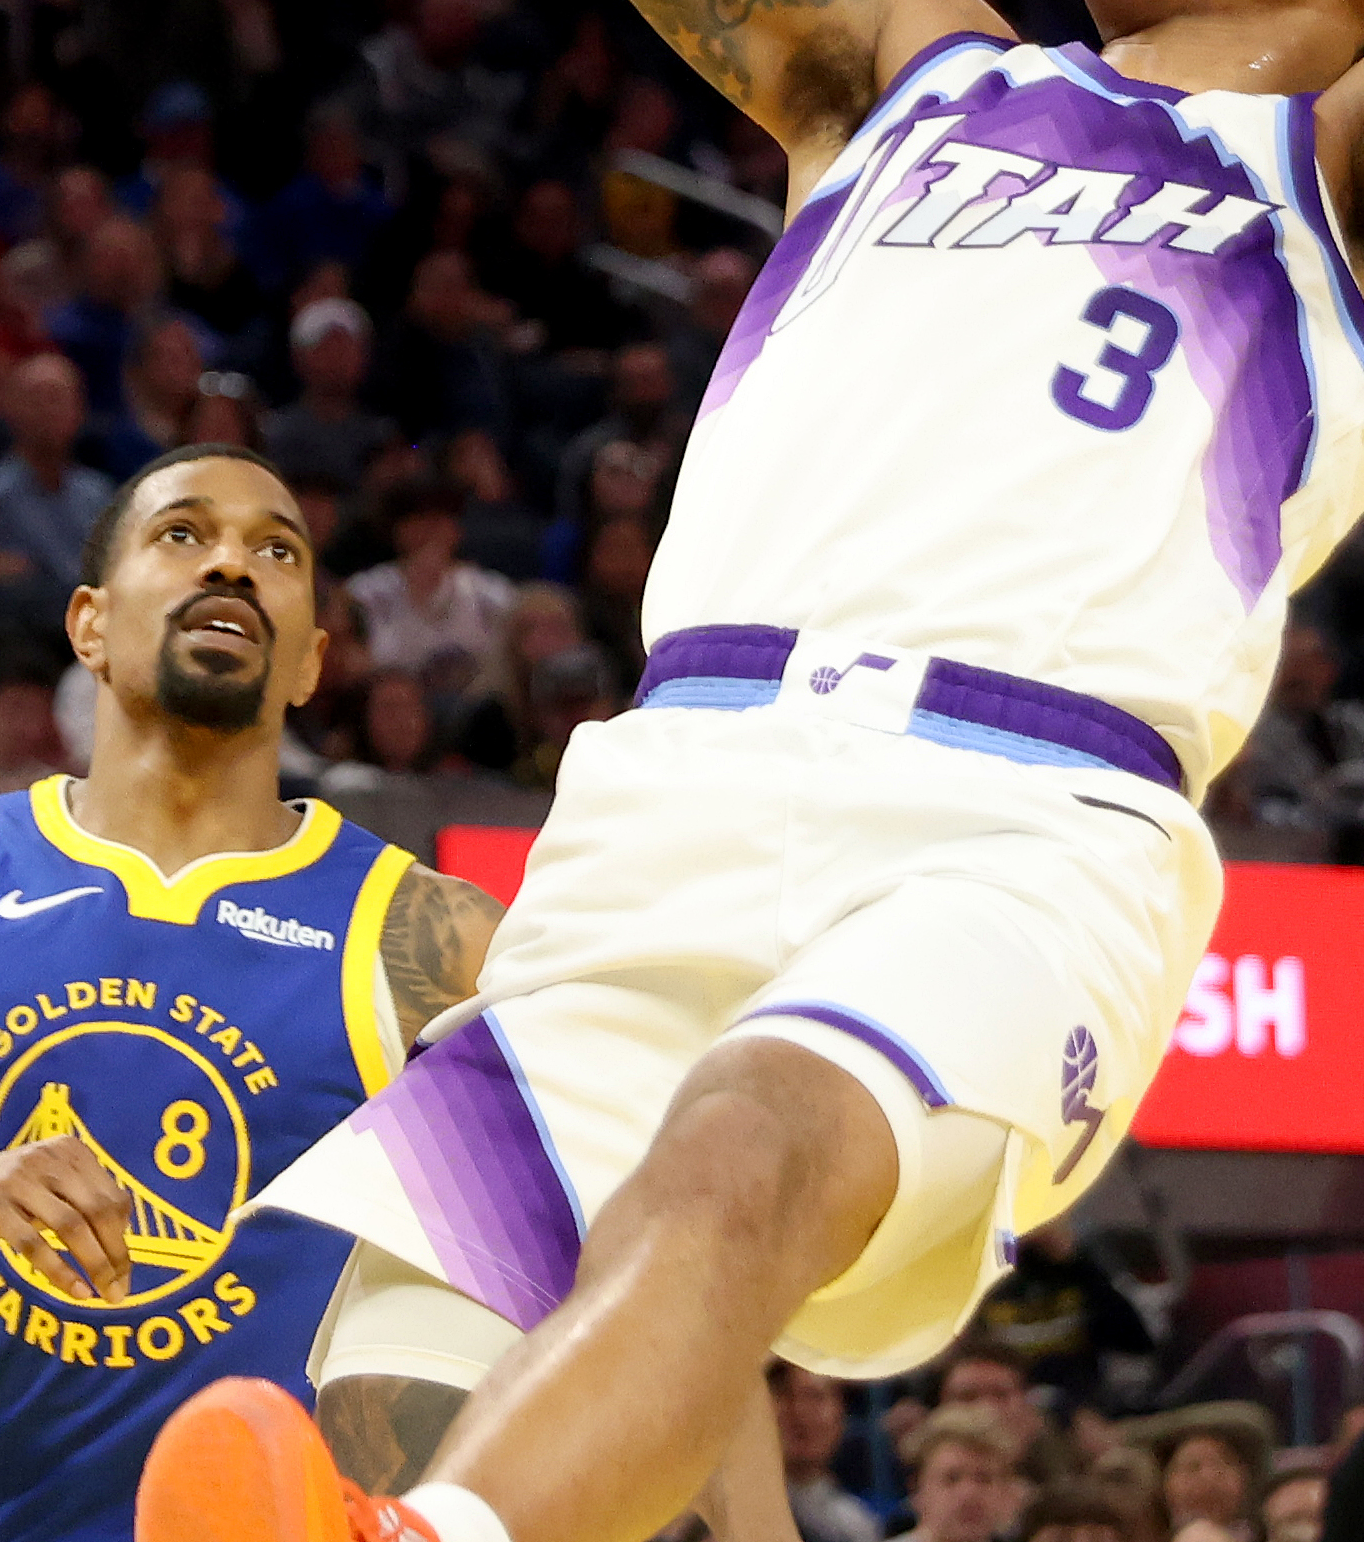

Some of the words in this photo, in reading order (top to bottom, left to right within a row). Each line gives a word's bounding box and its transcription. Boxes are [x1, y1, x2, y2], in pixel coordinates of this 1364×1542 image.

[769, 111, 1284, 333] UTAH
[1048, 283, 1182, 433] 3
[216, 899, 335, 951] Rakuten
[168, 993, 280, 1096] STATE
[1173, 953, 1309, 1059] SH
[153, 1099, 212, 1180] 8
